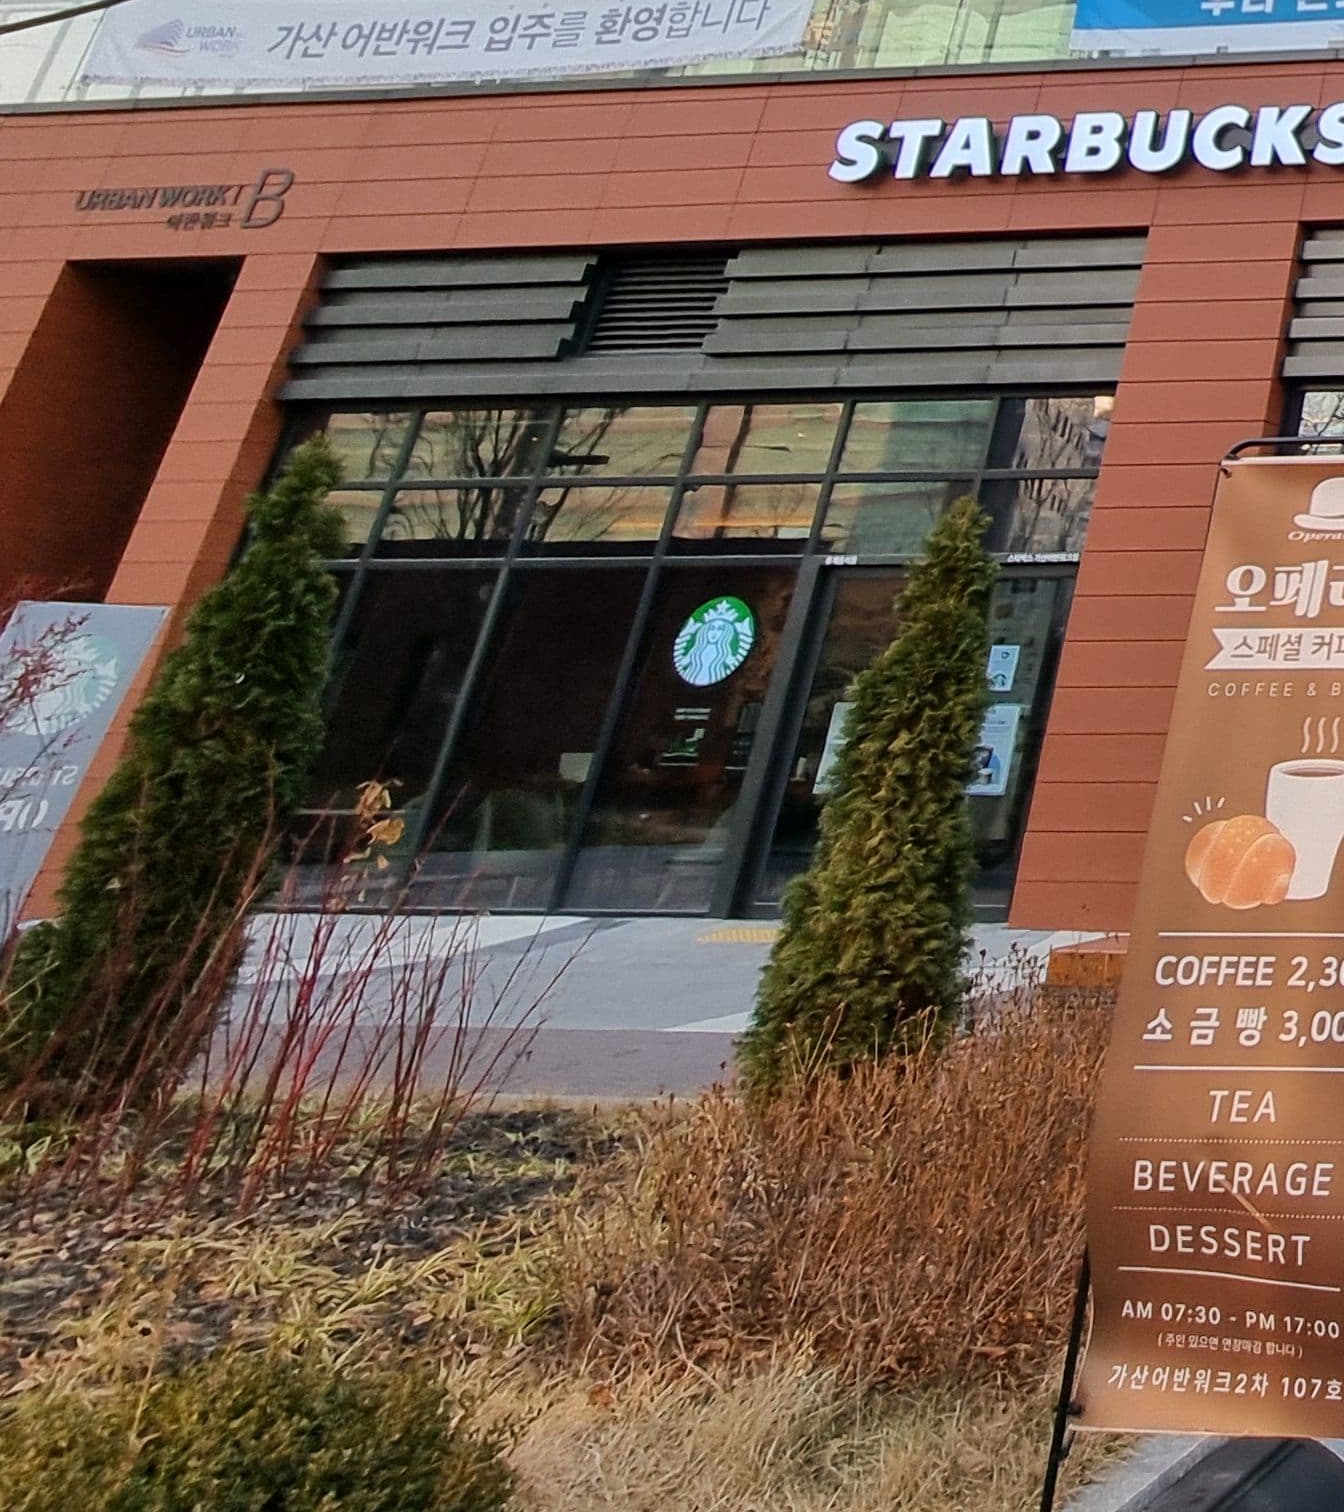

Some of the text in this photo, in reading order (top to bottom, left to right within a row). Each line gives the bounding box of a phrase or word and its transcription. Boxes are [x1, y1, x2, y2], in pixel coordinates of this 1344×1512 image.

[268, 19, 337, 62] 가산
[340, 14, 473, 60] 어반워크
[484, 8, 588, 53] 입주를
[76, 188, 156, 210] URBAN
[240, 168, 294, 229] B
[1230, 633, 1304, 662] 스페셜
[1208, 681, 1294, 697] COFFEE
[1307, 682, 1317, 697] &
[1155, 955, 1275, 987] COFFEE
[1210, 1090, 1276, 1123] TEA
[1133, 1159, 1334, 1197] BEVERAGE
[1150, 1224, 1311, 1266] DESSERT
[1121, 1300, 1152, 1320] AM
[1160, 1303, 1221, 1325] 07:30
[1245, 1311, 1275, 1331] PM
[1283, 1316, 1340, 1339] 17:00
[1108, 1363, 1343, 1401] 가산어반워크2차 107호
